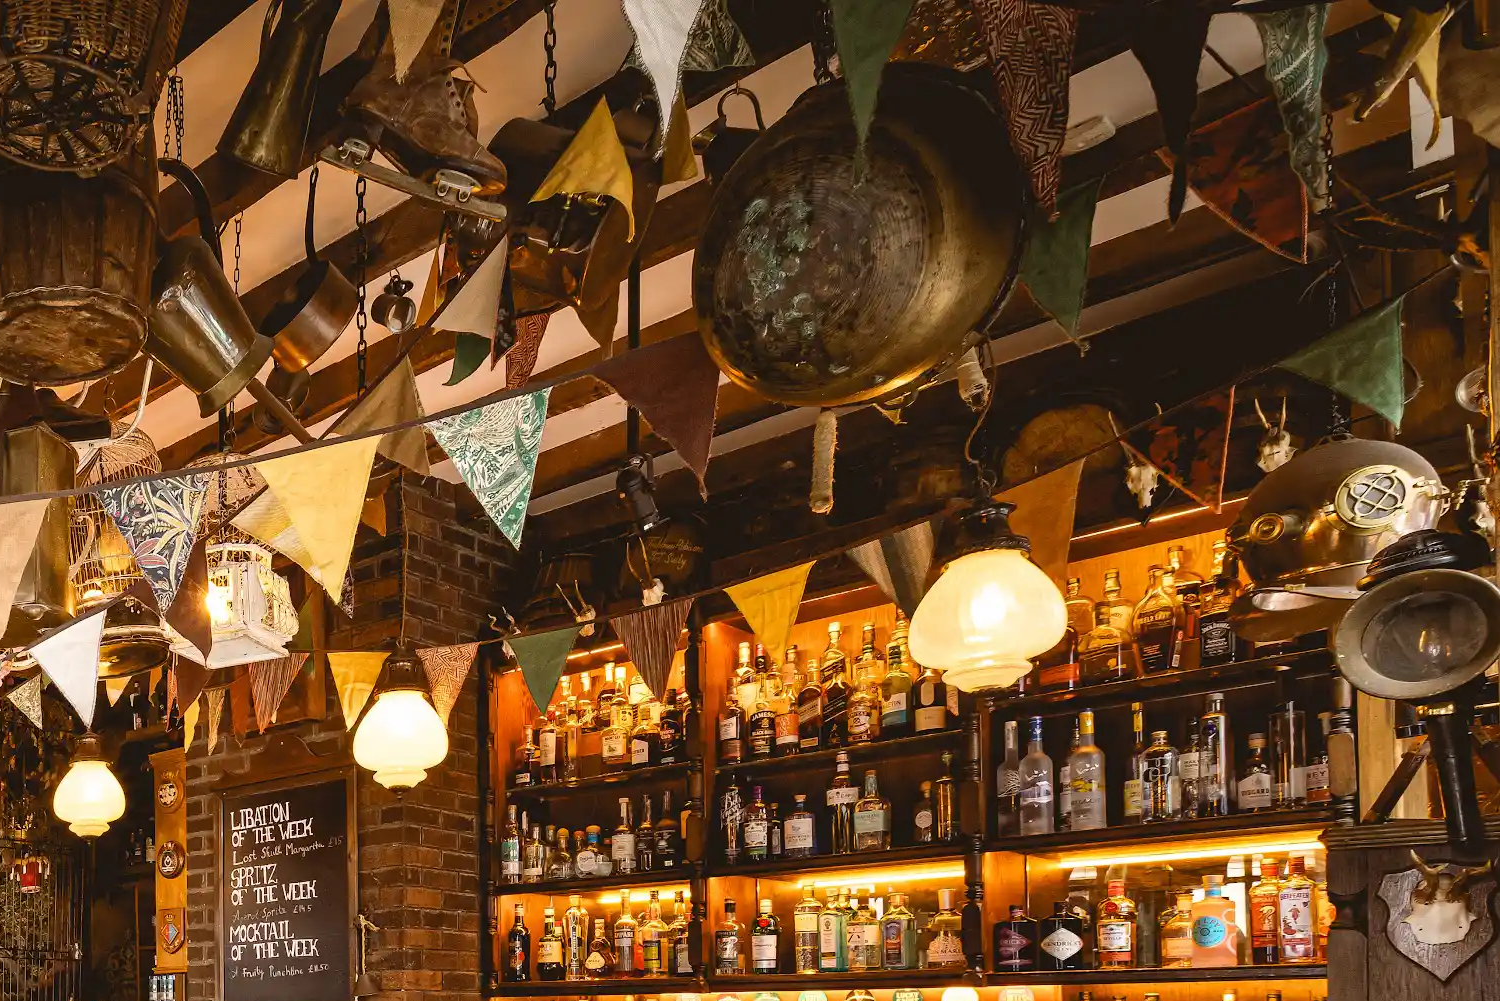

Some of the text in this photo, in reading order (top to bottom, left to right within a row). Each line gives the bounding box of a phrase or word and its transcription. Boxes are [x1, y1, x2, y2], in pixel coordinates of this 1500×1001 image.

[230, 801, 290, 831] LIBATION
[231, 817, 314, 848] OF THE WEEK
[230, 863, 278, 889] SPRITZ
[231, 880, 318, 906] OF THE WEEK
[229, 920, 295, 943] MOCKTAIL
[230, 938, 320, 961] OF THE WEEK
